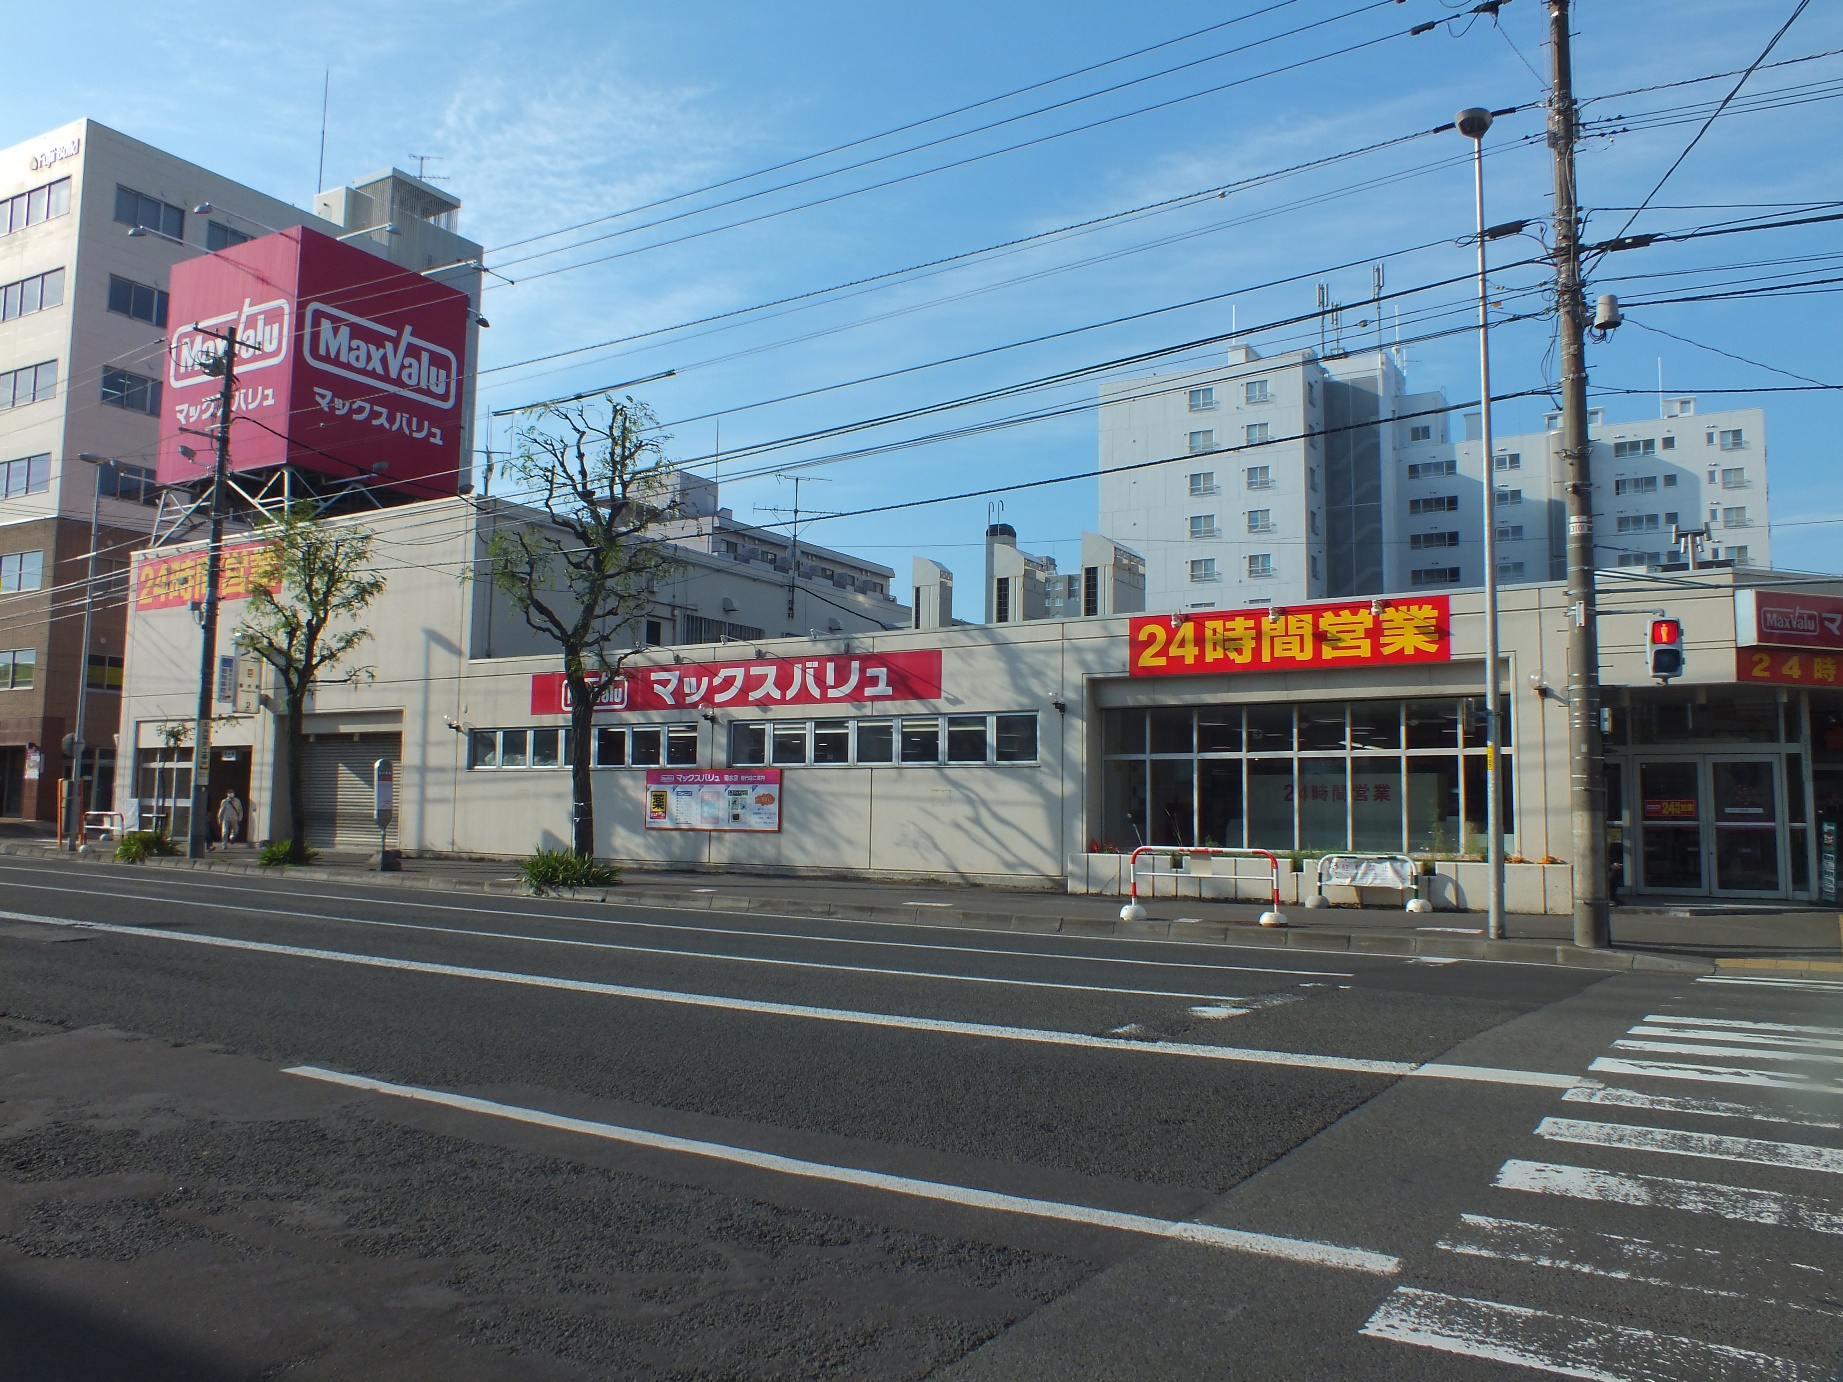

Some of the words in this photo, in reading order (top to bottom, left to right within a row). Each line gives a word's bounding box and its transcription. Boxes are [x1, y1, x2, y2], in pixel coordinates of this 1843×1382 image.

[318, 317, 447, 395] MaxValu
[313, 387, 443, 446] マックスバリュ
[1137, 604, 1439, 667] 24時間営業
[1766, 606, 1815, 631] MaxValu
[651, 660, 893, 705] マックスバリュ
[676, 773, 720, 782] マックスバリュ
